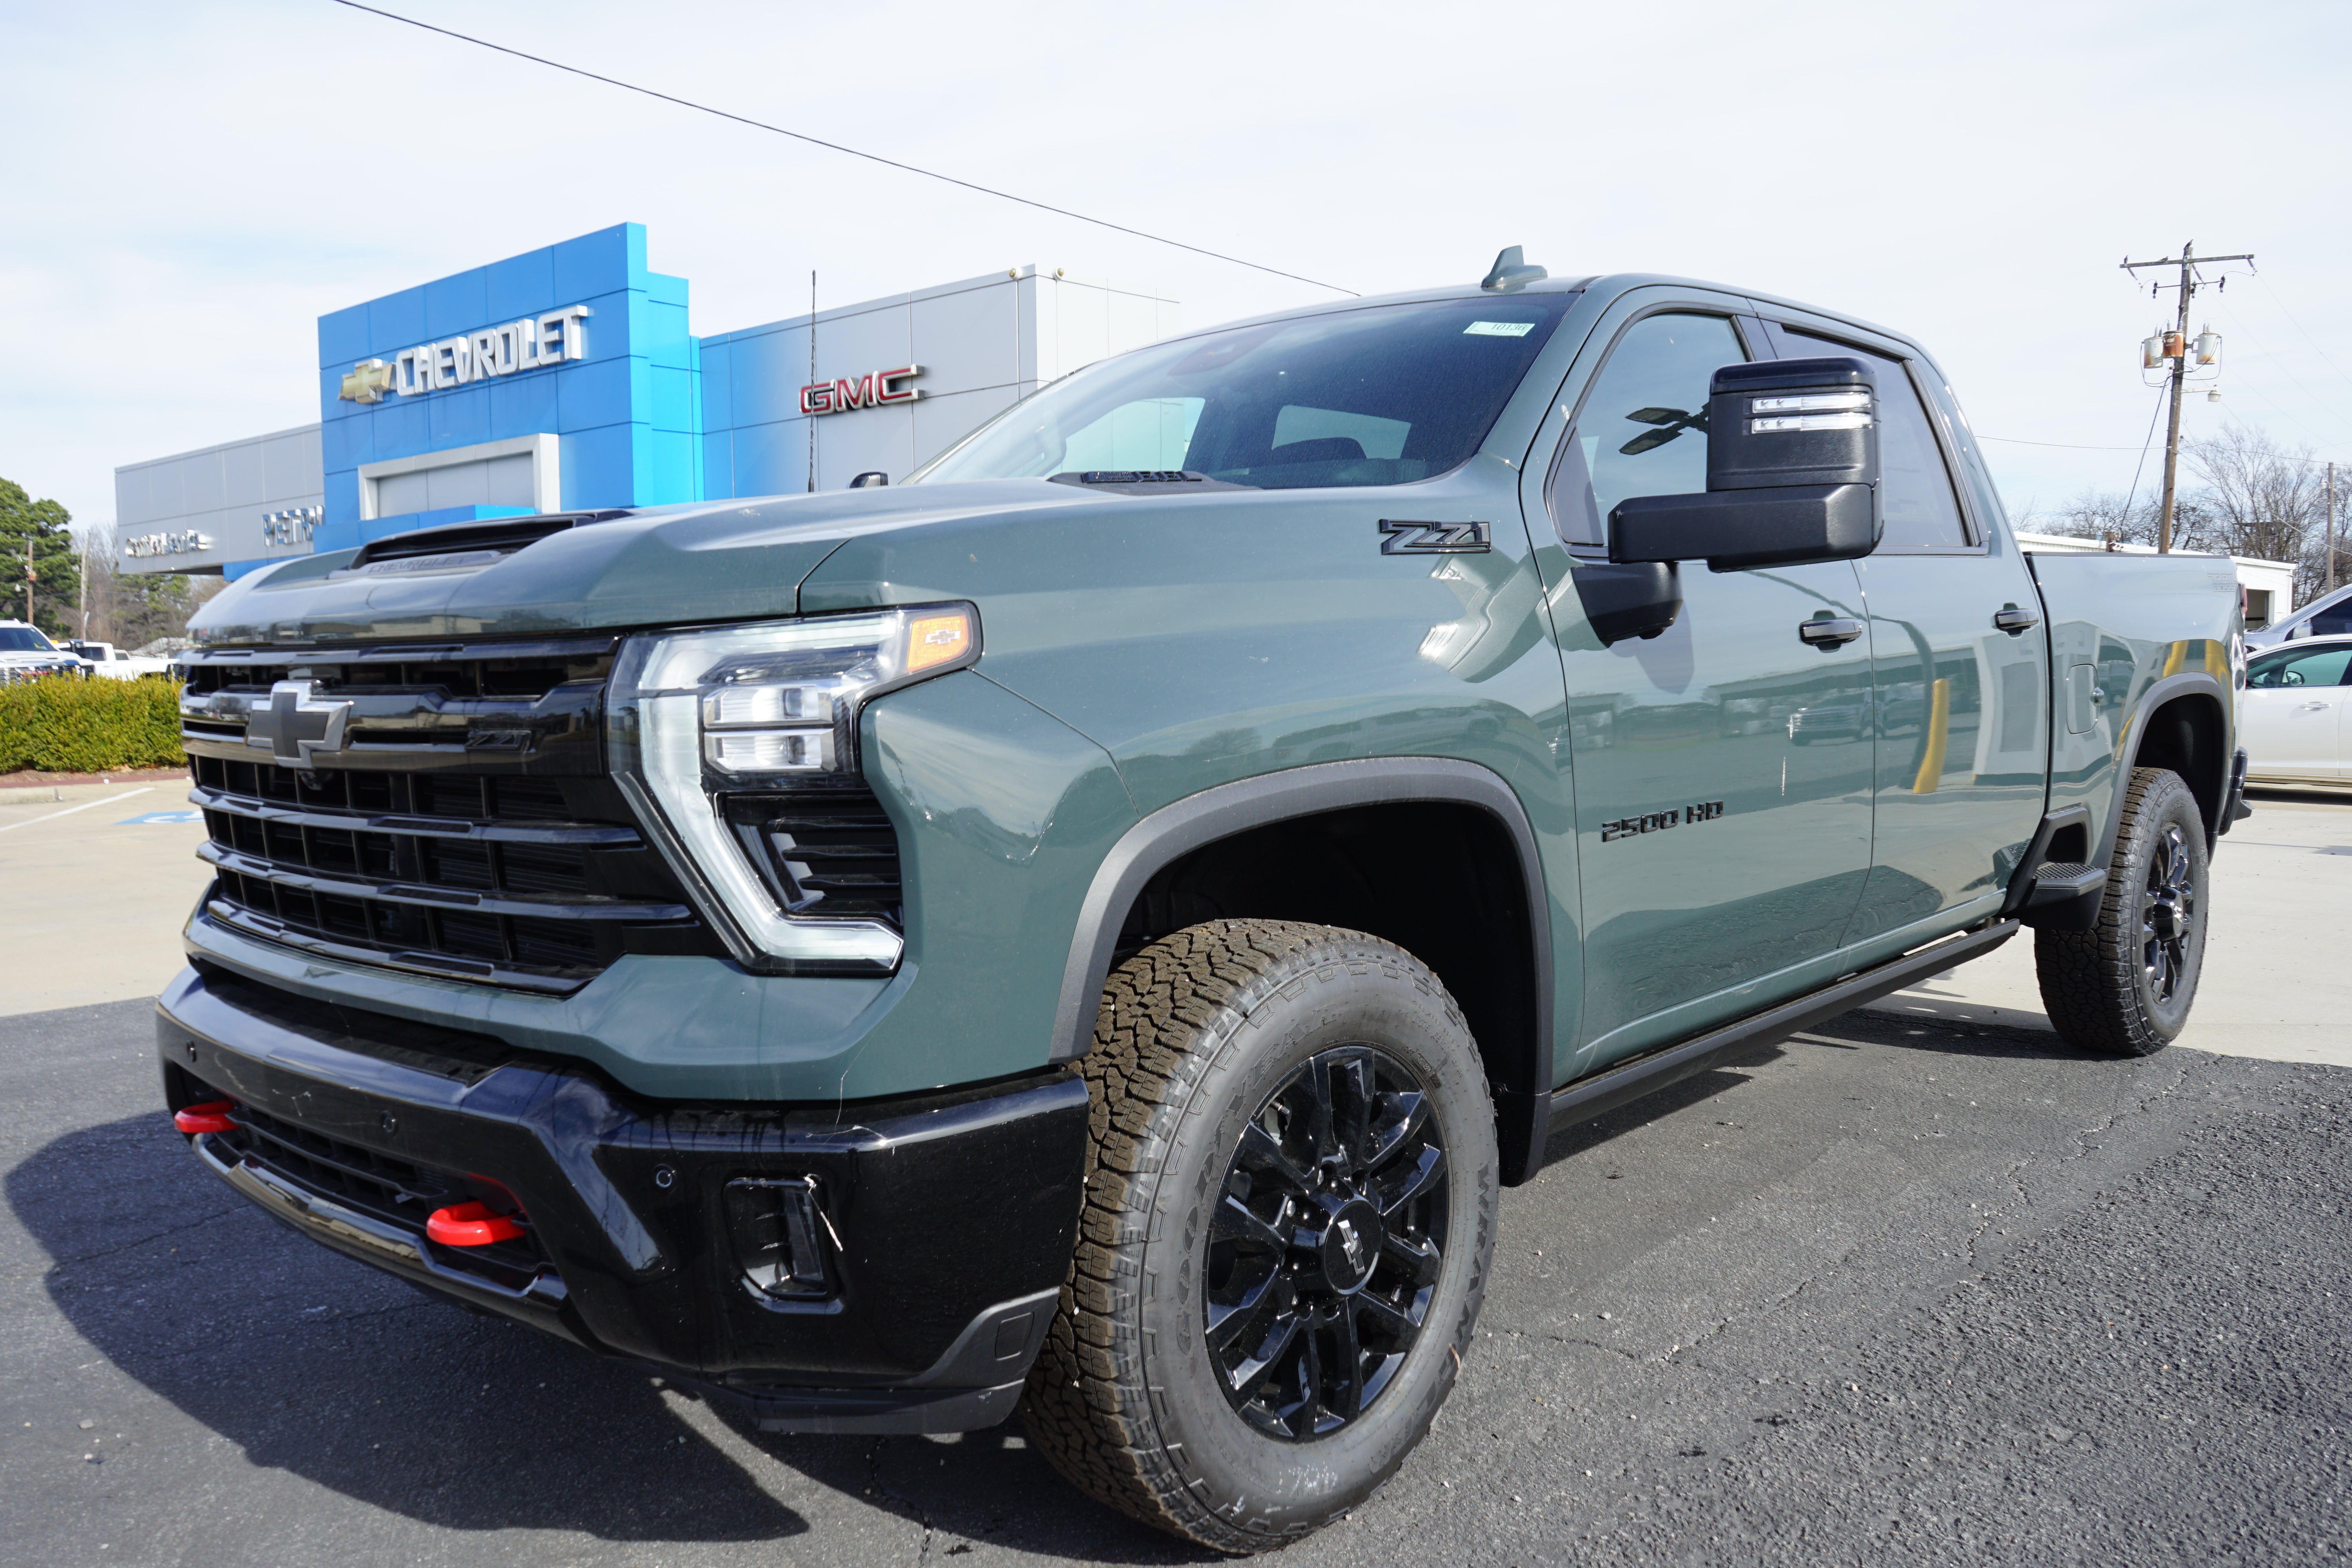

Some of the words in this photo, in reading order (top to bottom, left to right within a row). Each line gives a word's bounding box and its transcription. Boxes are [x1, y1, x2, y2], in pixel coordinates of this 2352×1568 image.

[396, 305, 589, 396] CHEVROLET
[800, 364, 924, 416] GMC
[368, 557, 464, 573] CHEVROLET
[2207, 573, 2236, 584] TRAIL
[2213, 584, 2235, 592] BOSS
[1602, 808, 1679, 842] 2500
[1686, 800, 1723, 824] HD
[1176, 1002, 1339, 1356] GOODYEAR
